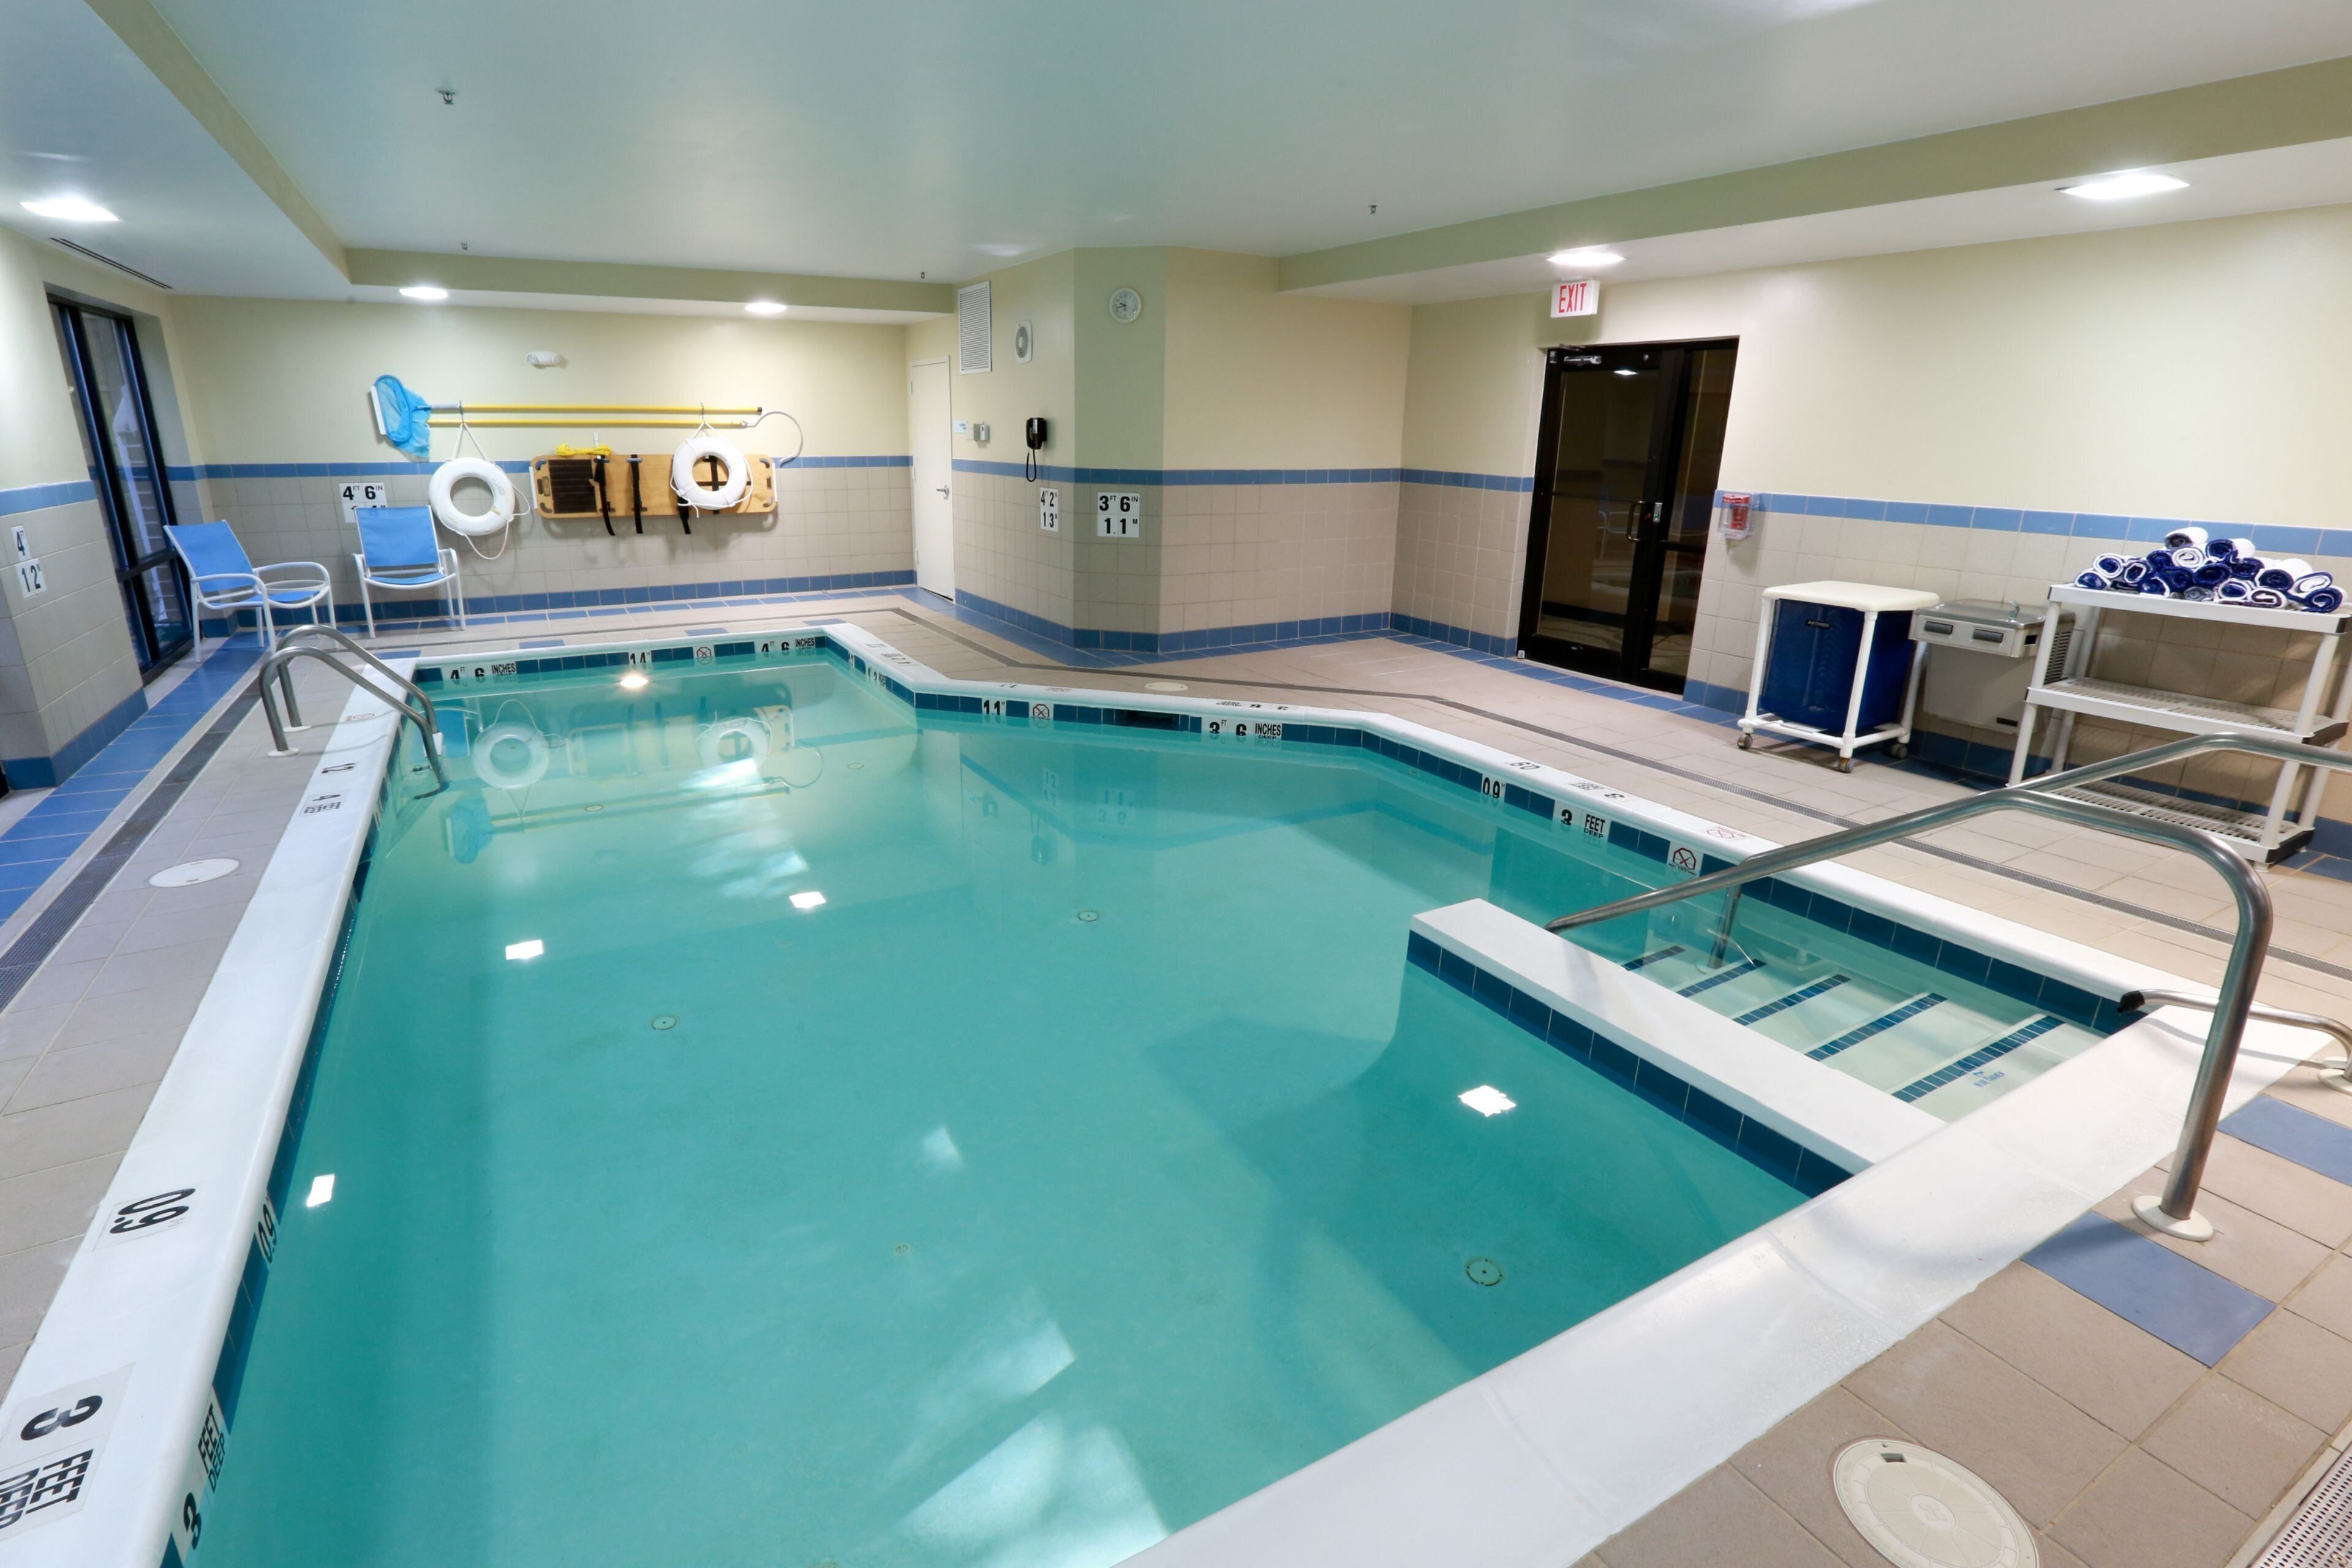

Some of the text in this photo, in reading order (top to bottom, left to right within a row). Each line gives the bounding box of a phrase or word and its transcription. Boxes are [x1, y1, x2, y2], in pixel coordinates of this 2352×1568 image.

[1558, 283, 1588, 313] EXIT
[342, 486, 354, 500] 4
[364, 486, 376, 500] 6
[1041, 491, 1046, 506] 4
[1049, 492, 1054, 507] 2
[1099, 496, 1109, 511] 3
[1120, 496, 1130, 513] 6
[17, 532, 25, 556] 4
[795, 638, 815, 647] INCHES
[492, 663, 516, 673] INCHES
[1255, 723, 1281, 737] INCHES
[1583, 827, 1604, 839] DEEP
[1585, 813, 1606, 834] FEET
[109, 1188, 196, 1234] 0.9
[20, 1395, 103, 1441] 3
[198, 1402, 220, 1474] FEET
[208, 1432, 226, 1493] DEEP
[25, 1449, 94, 1515] FEET
[184, 1492, 202, 1550] 3
